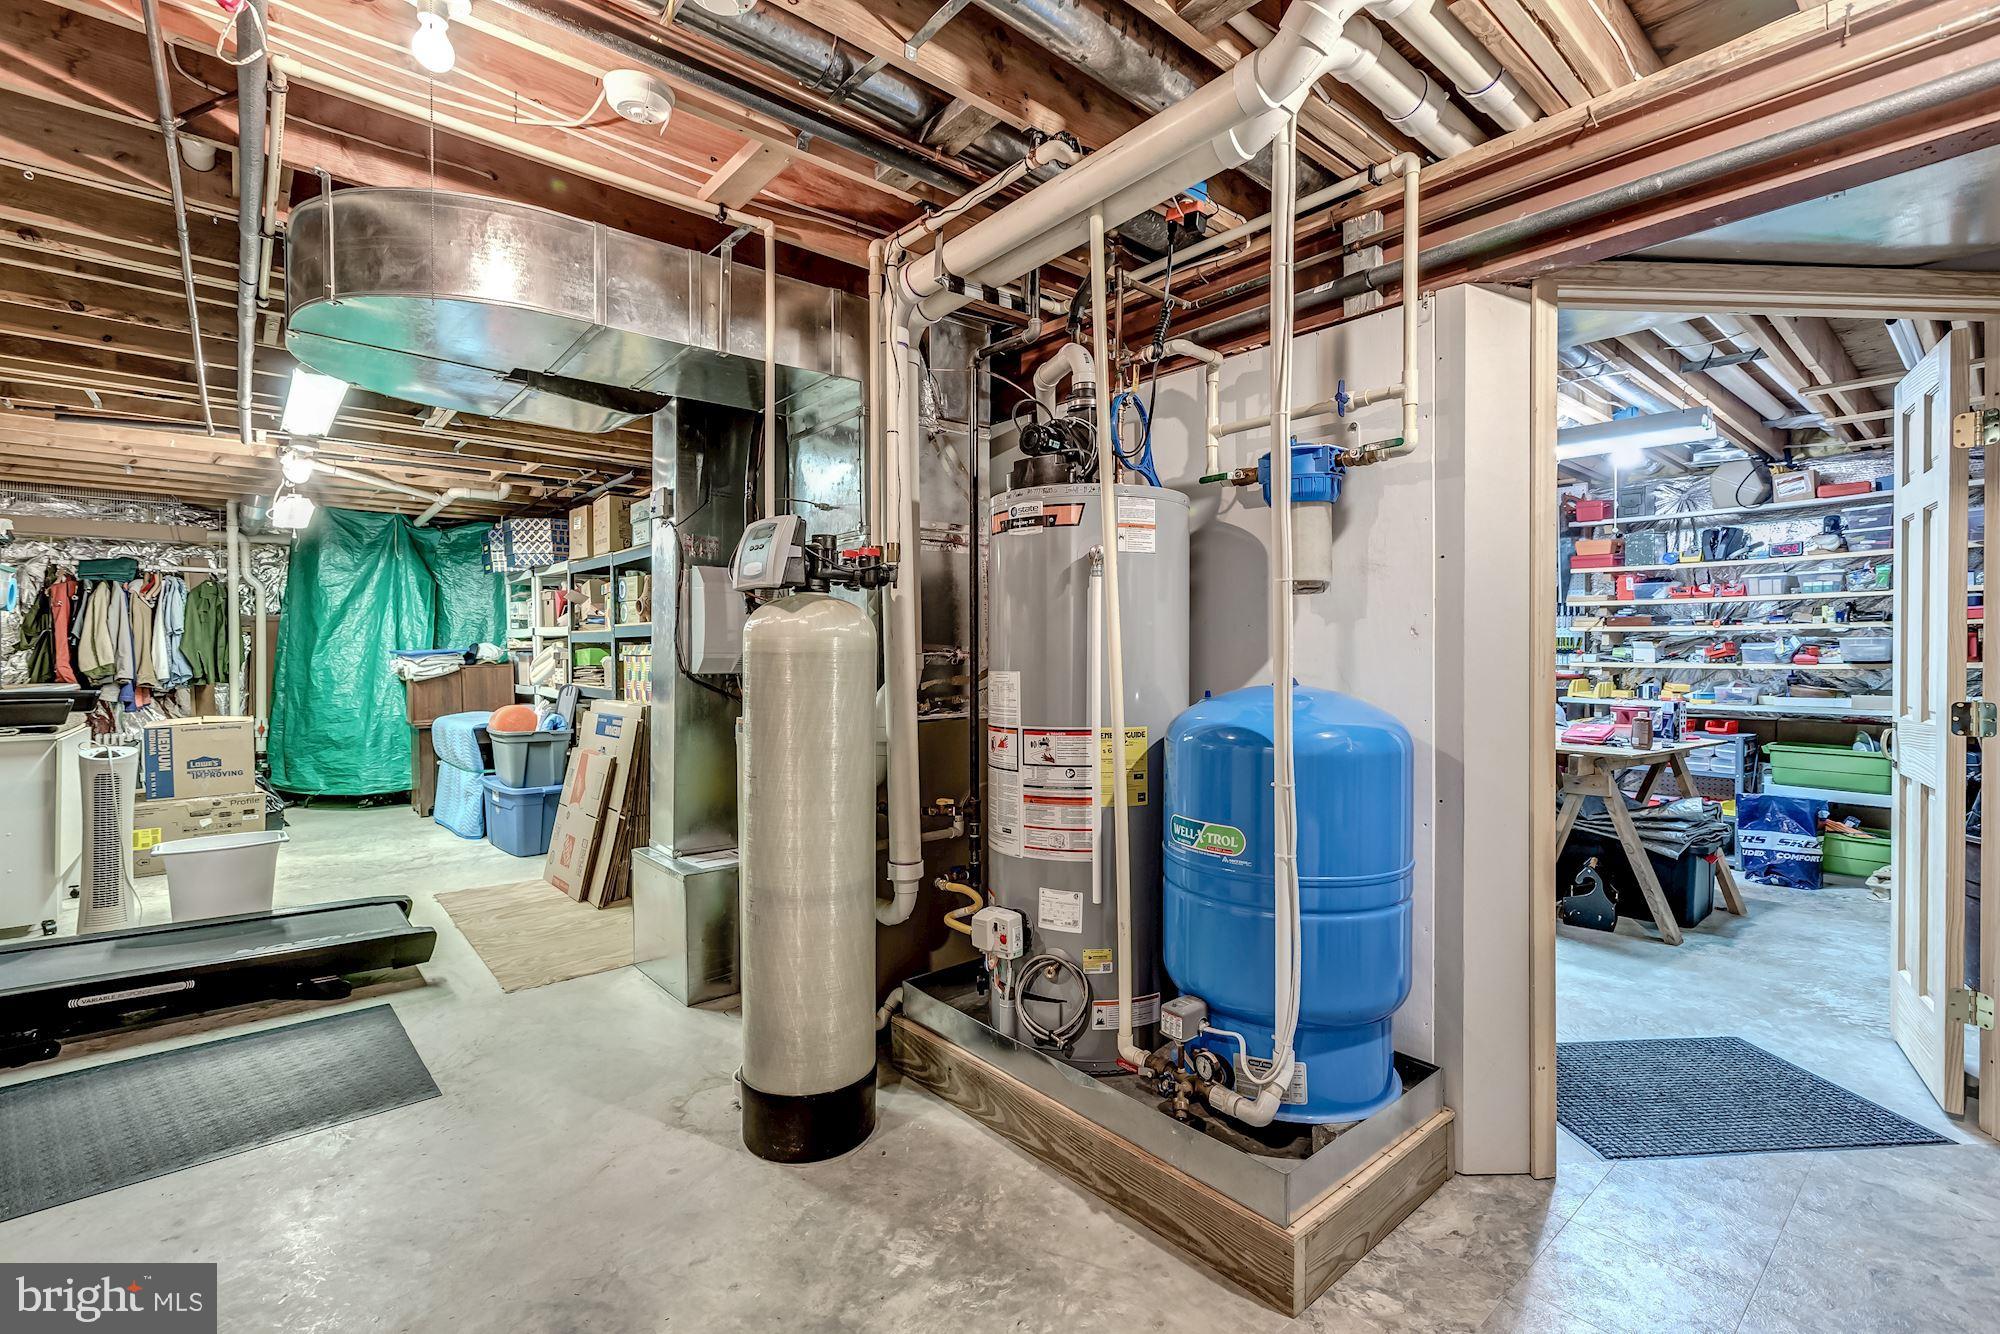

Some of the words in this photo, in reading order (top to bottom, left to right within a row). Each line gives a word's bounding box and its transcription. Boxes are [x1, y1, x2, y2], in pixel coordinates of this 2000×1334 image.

[1018, 505, 1039, 513] state
[157, 728, 171, 772] MEDIUM
[192, 769, 244, 779] IMPROVING
[230, 798, 260, 806] Profile
[1776, 852, 1820, 862] COMFORT
[81, 994, 116, 1005] VARIABLE
